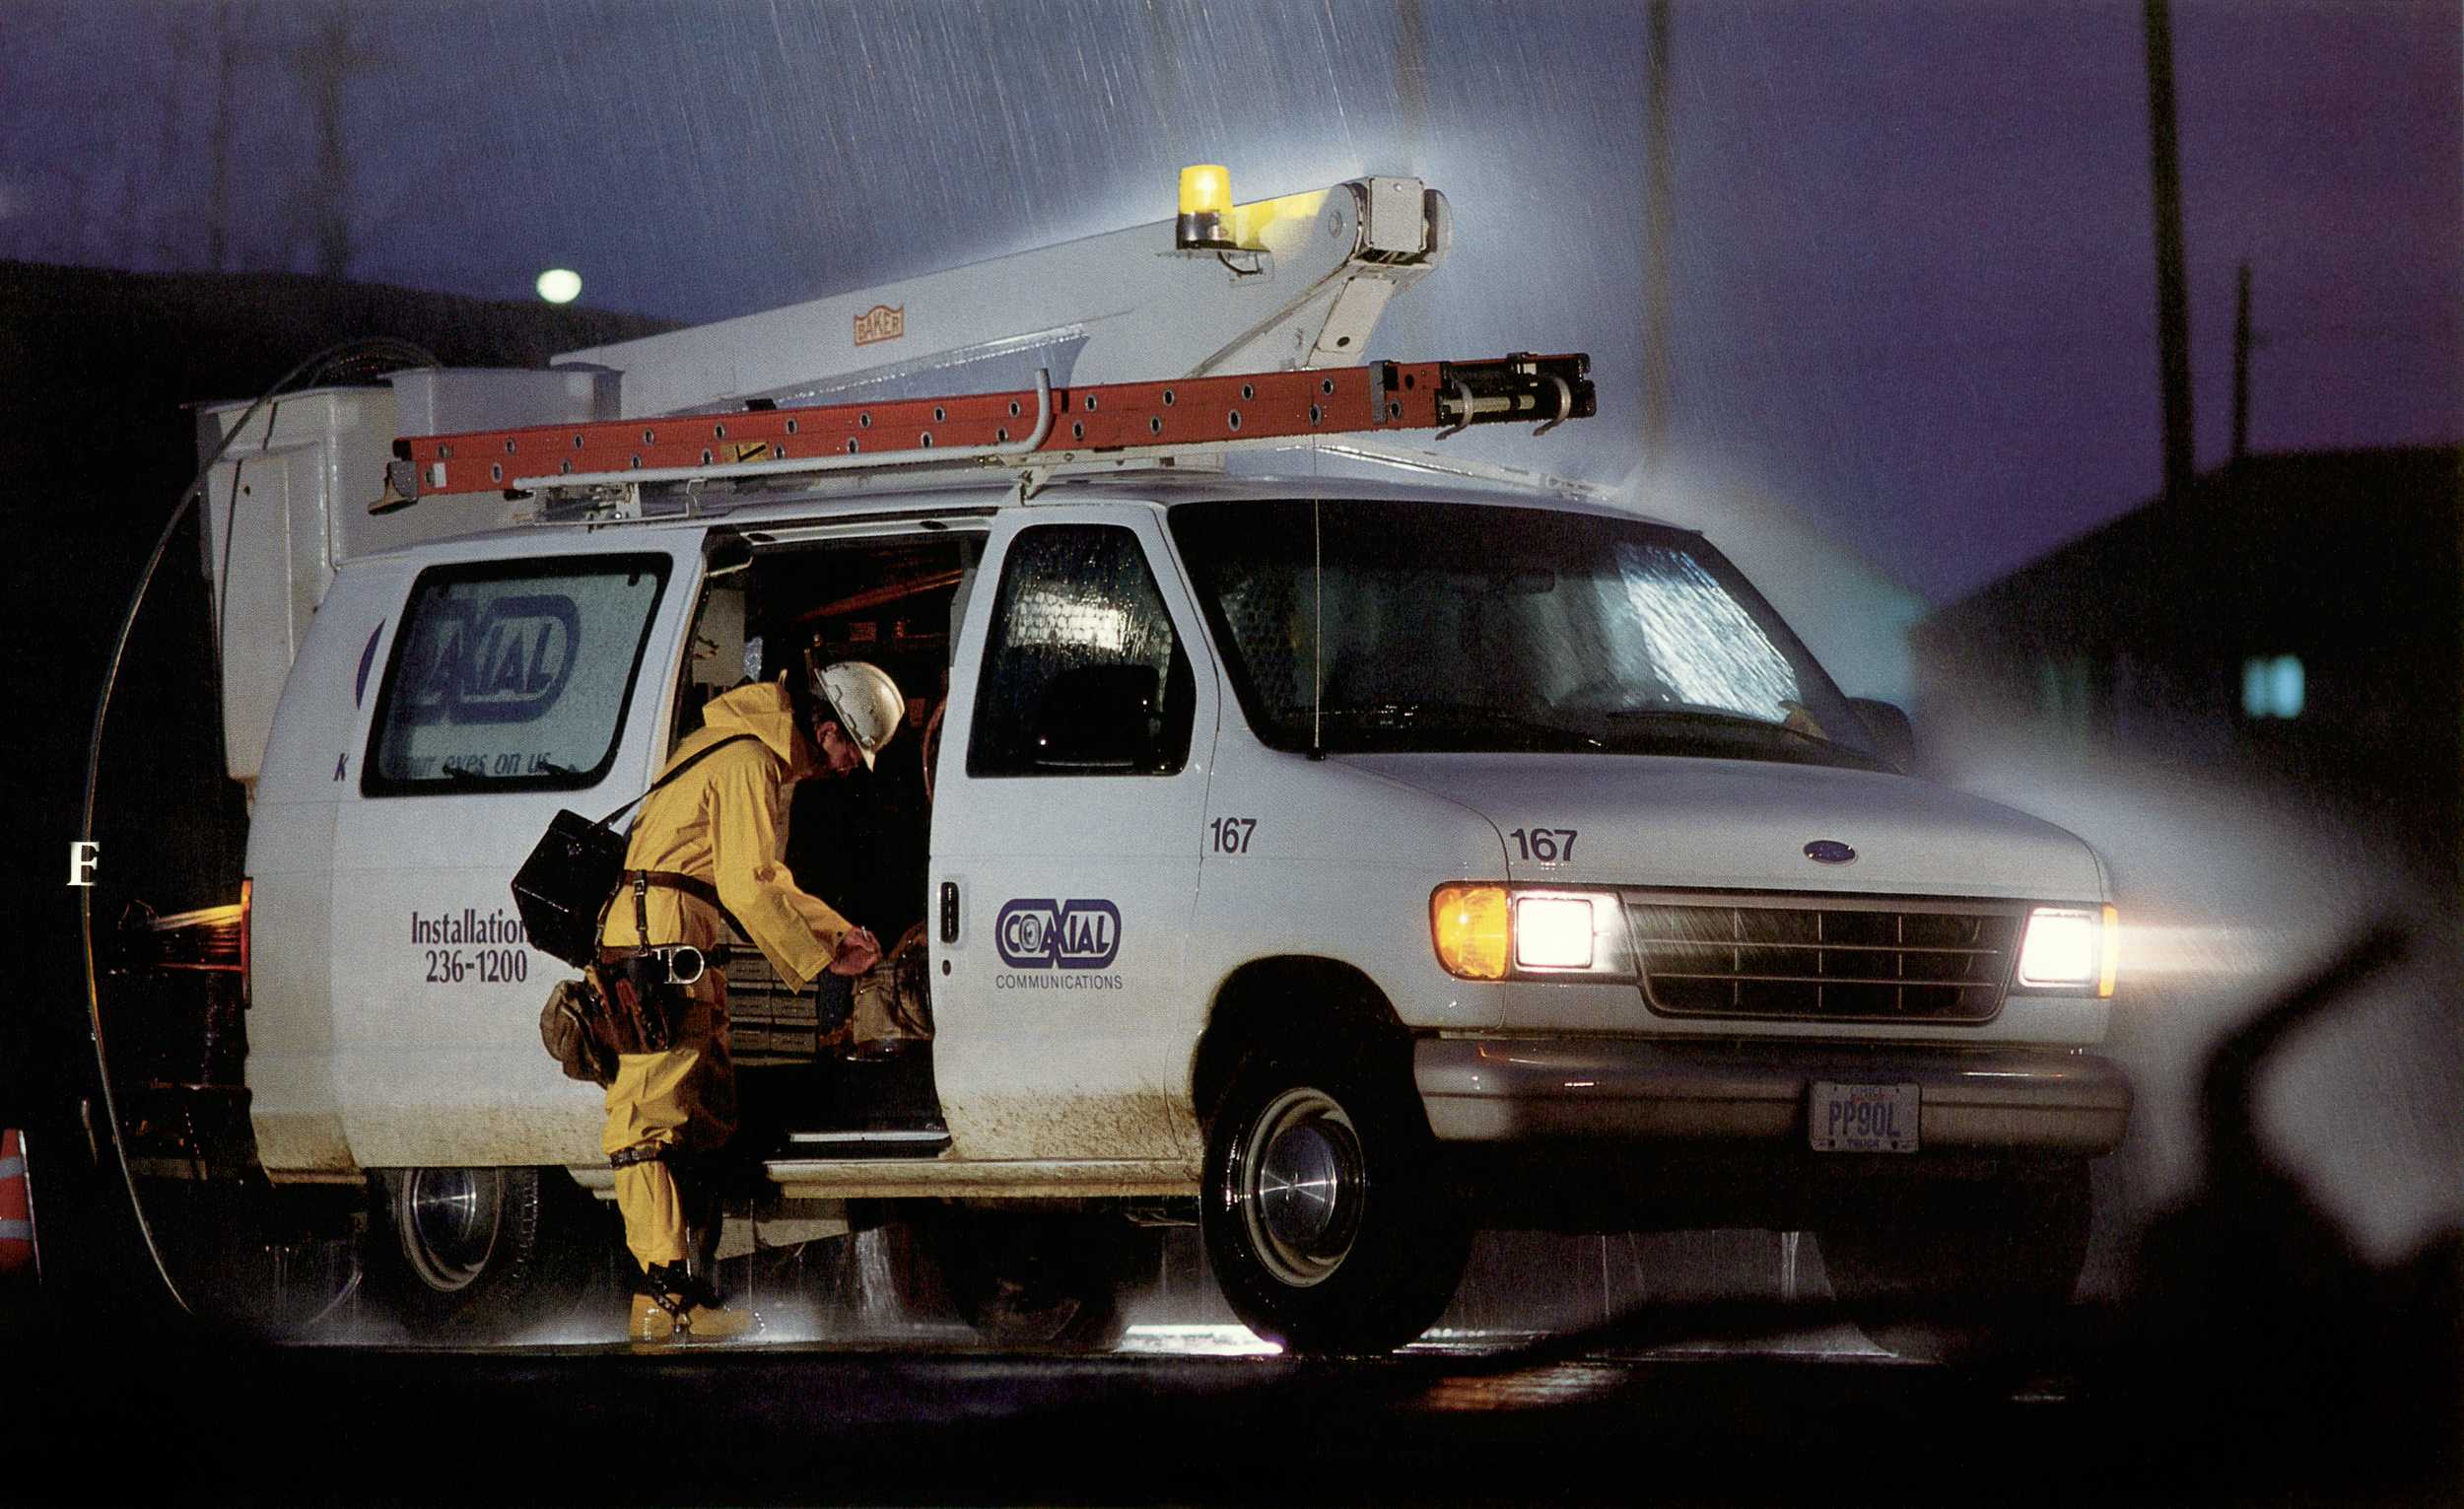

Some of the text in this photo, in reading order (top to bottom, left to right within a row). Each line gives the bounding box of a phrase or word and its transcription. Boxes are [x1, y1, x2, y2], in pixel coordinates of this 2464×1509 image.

[857, 310, 900, 341] BAKER
[495, 752, 522, 775] on
[1209, 817, 1257, 854] 167
[1510, 828, 1577, 861] 167
[1002, 898, 1113, 969] COAXIAL
[426, 949, 527, 983] 236-1200
[995, 974, 1123, 990] COMMUNICATIONS
